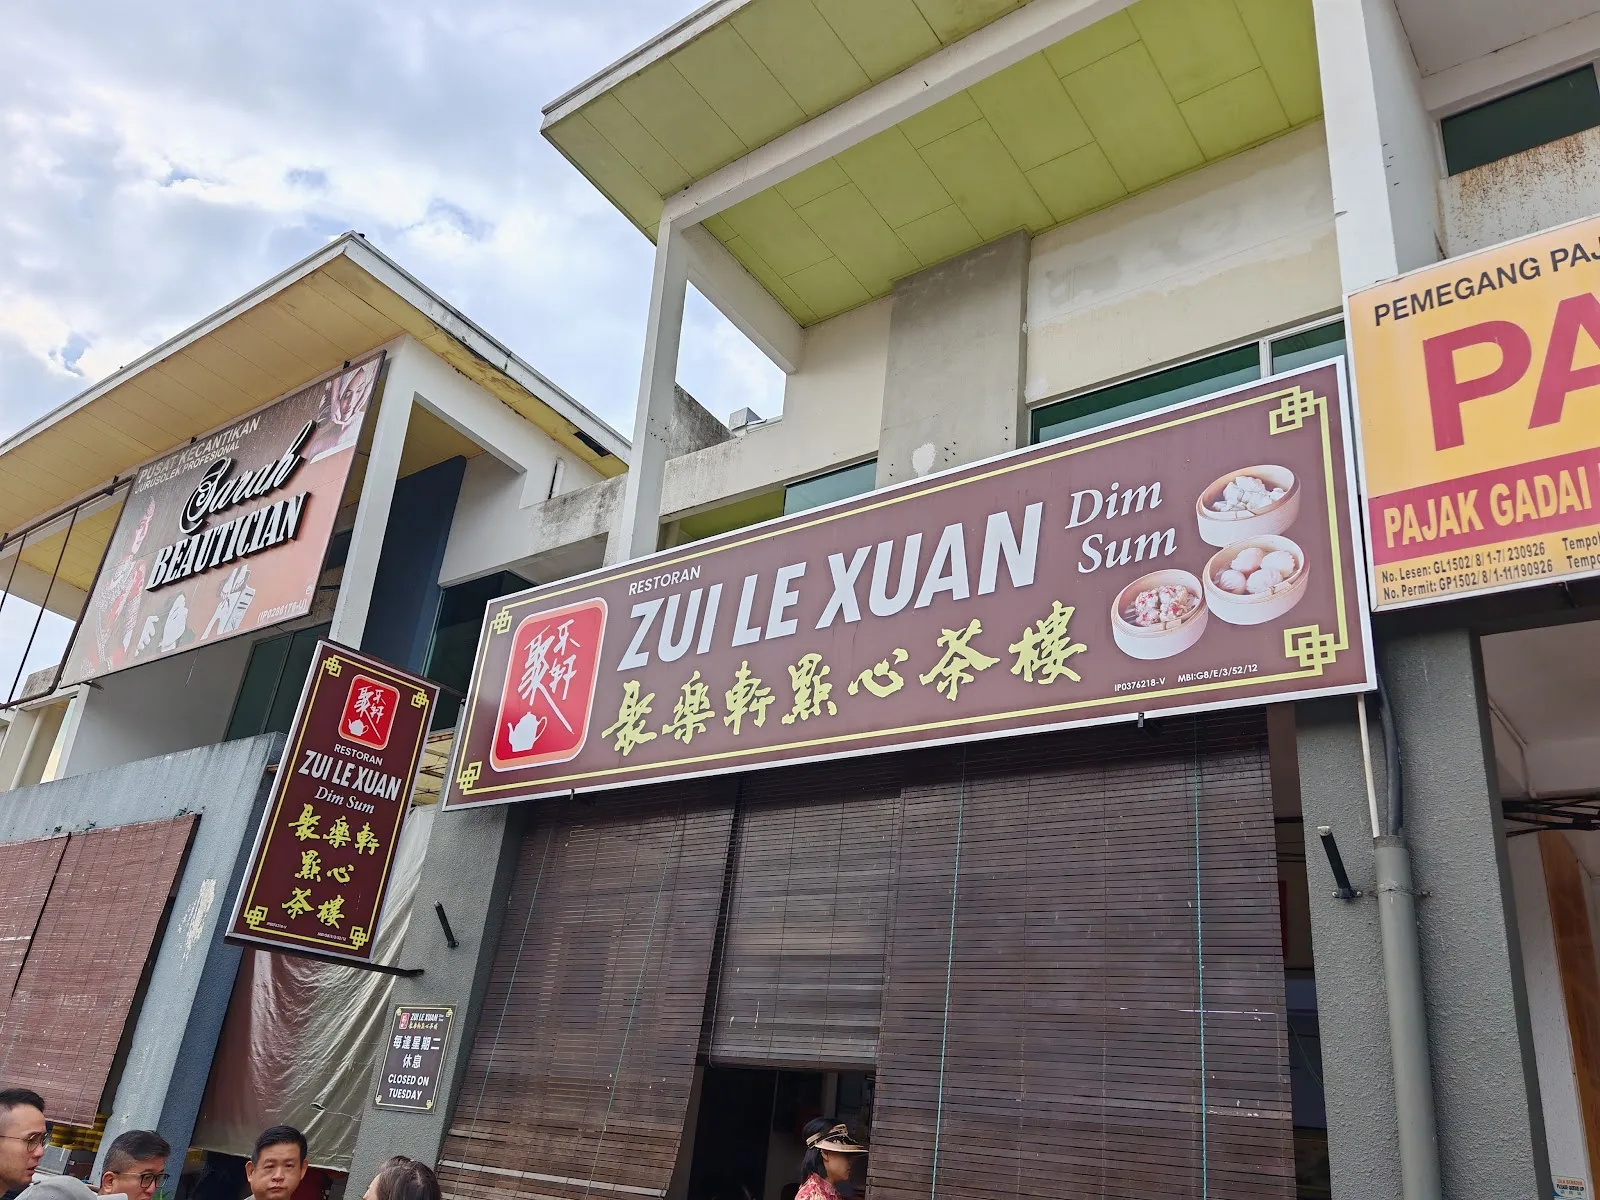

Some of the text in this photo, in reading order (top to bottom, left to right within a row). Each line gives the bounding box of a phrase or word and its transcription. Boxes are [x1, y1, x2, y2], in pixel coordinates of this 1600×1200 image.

[1374, 257, 1542, 327] PEMEGANG
[138, 416, 261, 483] PUSAT KECANTIKAN
[182, 440, 240, 473] PROFESIONAL
[179, 420, 316, 534] Sarah
[1064, 481, 1163, 530] Dim
[1383, 466, 1592, 548] PAJAK GADAI
[146, 492, 308, 592] BEAUTICIAN
[1077, 527, 1178, 574] Sum
[616, 501, 1044, 671] ZUI LE XUAN
[628, 565, 702, 596] RESTORAN
[1381, 570, 1398, 583] No.
[1399, 565, 1432, 581] Lesen:
[1383, 586, 1399, 600] No.
[1401, 580, 1437, 597] Permit:
[1114, 663, 1259, 692] IP0376218-V MBI:G8/E/3/52/12
[334, 743, 384, 767] RESTORAN
[298, 749, 402, 802] ZUI LE XUAN
[314, 785, 375, 815] Dim Sum
[281, 887, 345, 930] 茶樓
[392, 1034, 441, 1051] 每逢星期二
[402, 1054, 422, 1069] 休息
[387, 1074, 429, 1087] CLOSED ON
[388, 1088, 422, 1101] TUESDAY
